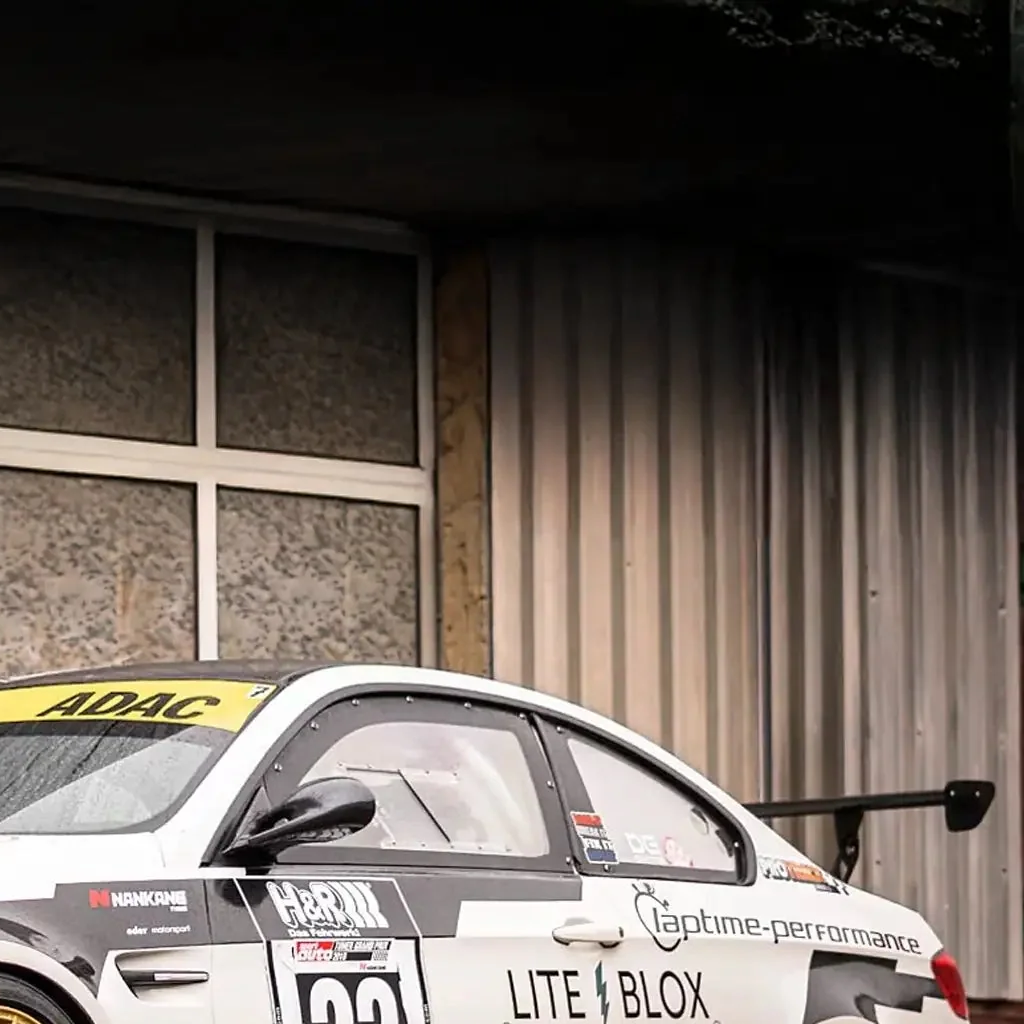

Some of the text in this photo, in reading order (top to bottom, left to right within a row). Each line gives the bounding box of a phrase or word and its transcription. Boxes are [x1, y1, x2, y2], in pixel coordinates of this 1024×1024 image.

[35, 691, 221, 719] ADAC
[266, 881, 354, 929] H&R
[651, 907, 923, 955] laptime-performance
[507, 970, 710, 1019] LITE BLOX
